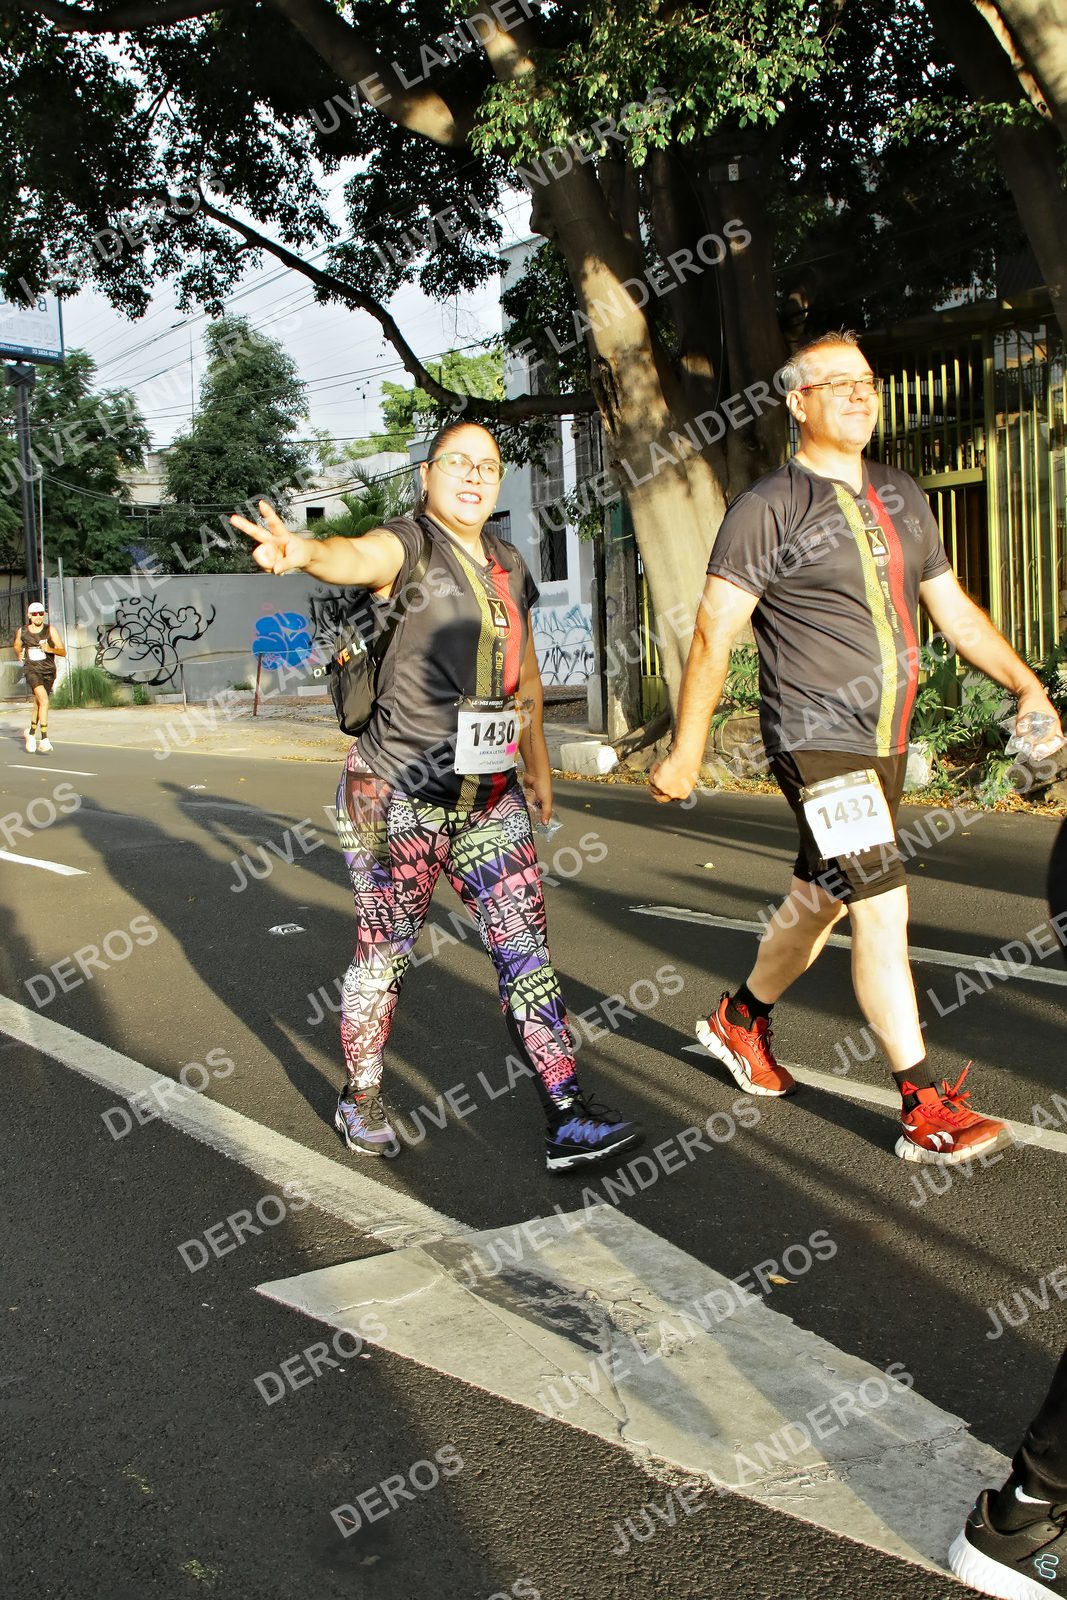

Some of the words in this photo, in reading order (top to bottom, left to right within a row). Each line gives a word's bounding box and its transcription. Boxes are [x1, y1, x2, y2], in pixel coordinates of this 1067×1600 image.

[117, 594, 157, 610] TOY
[471, 720, 515, 747] 1430
[818, 794, 878, 830] 1432
